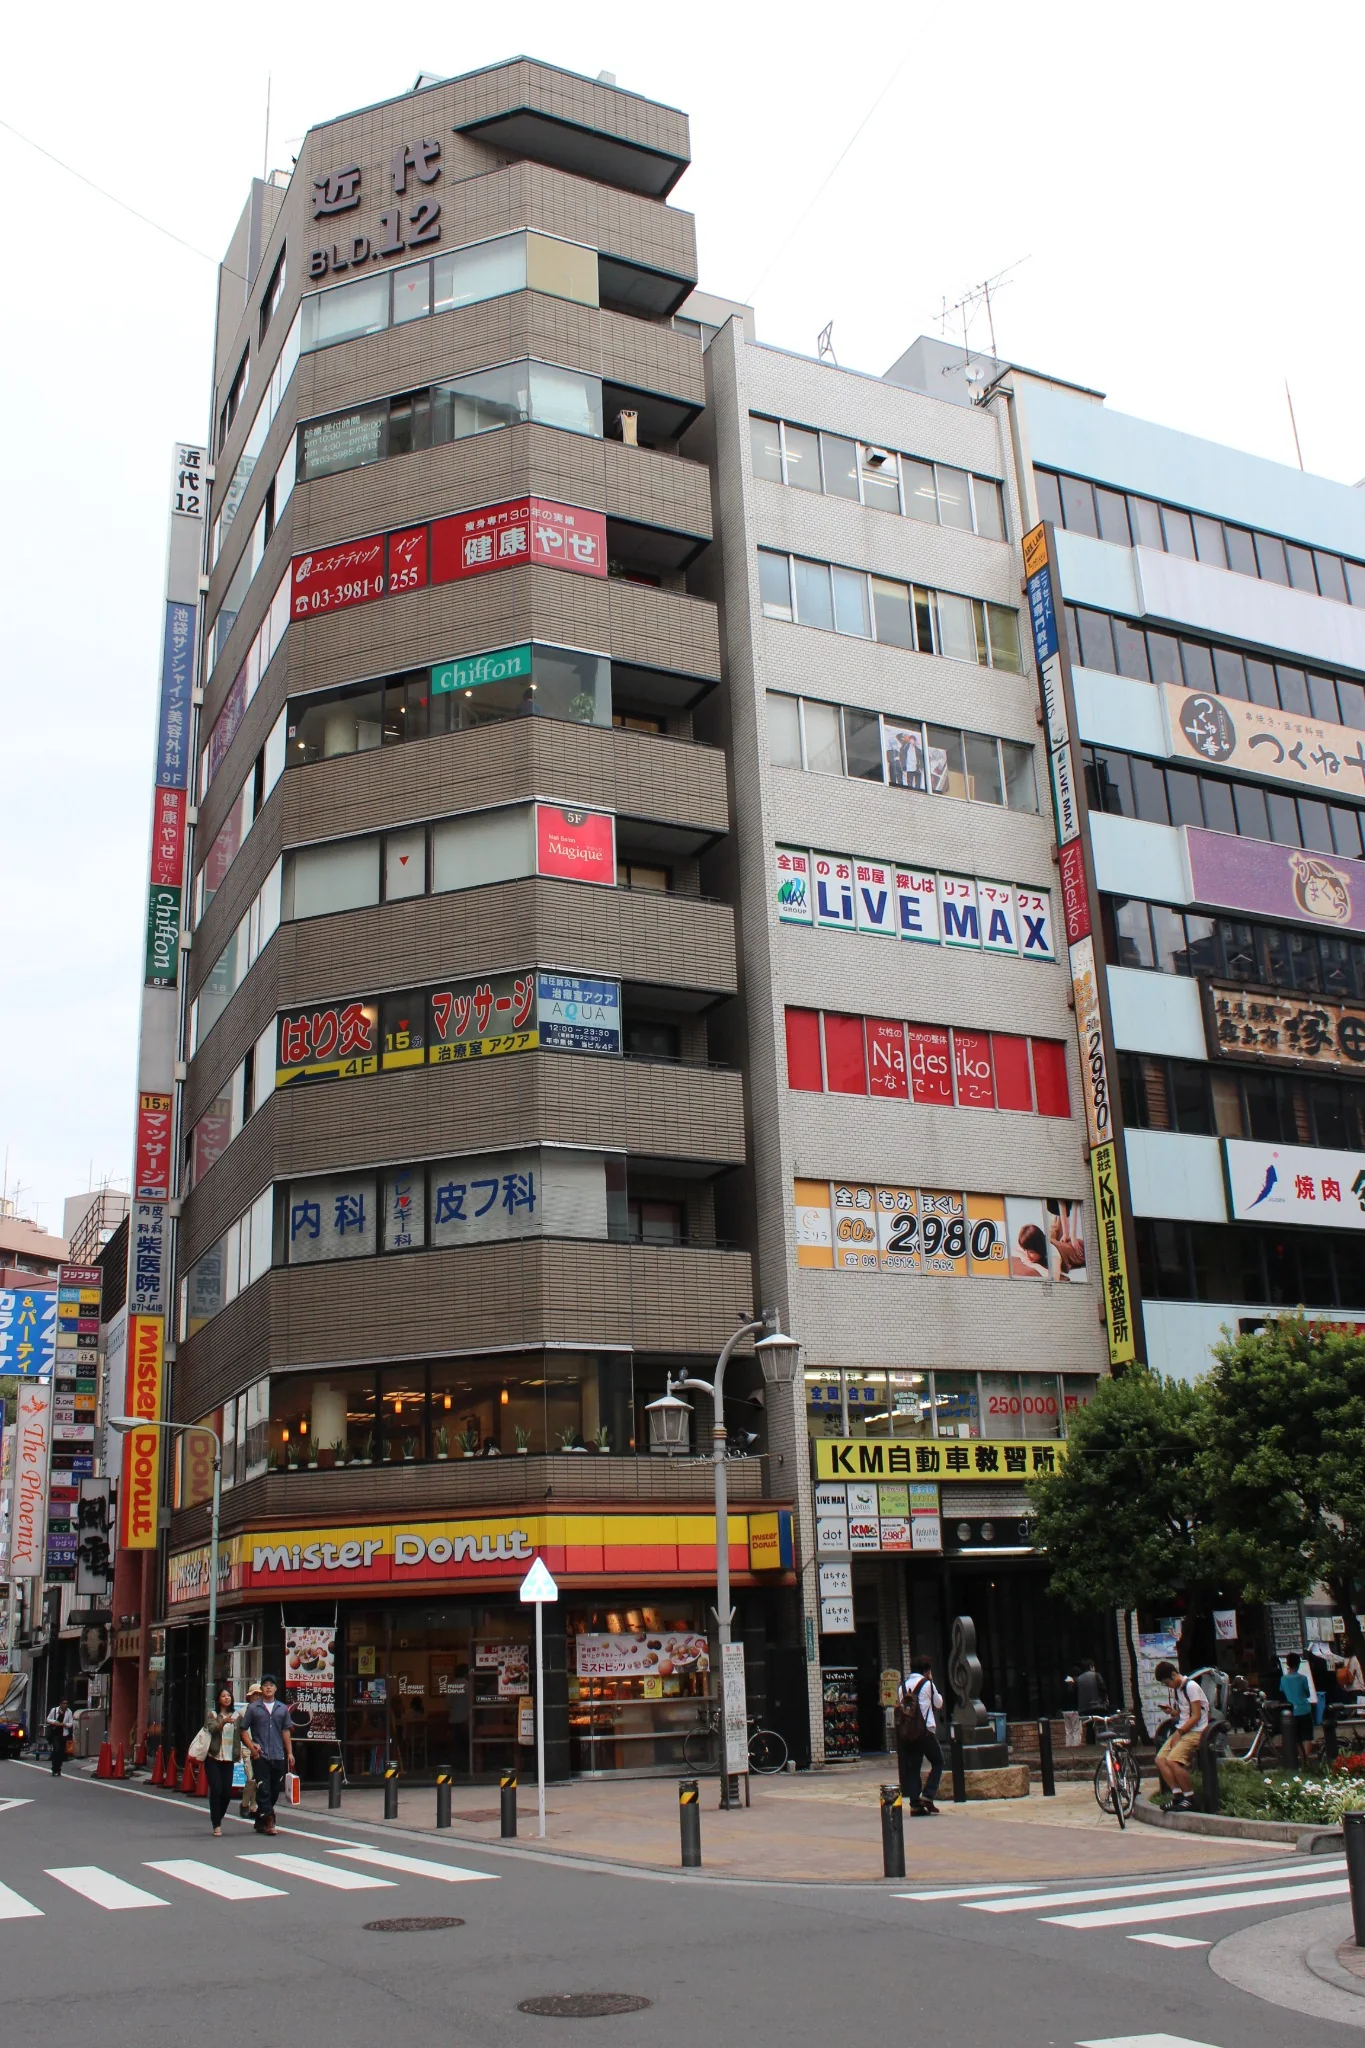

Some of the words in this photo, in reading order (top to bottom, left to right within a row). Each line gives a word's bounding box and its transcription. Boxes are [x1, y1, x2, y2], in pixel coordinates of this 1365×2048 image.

[313, 138, 441, 220] 近代
[308, 234, 378, 278] BLD.
[378, 200, 442, 257] 12
[178, 448, 201, 491] 近代
[175, 493, 200, 514] 12
[464, 526, 597, 566] 健康やせ
[439, 654, 522, 690] chiffon
[159, 791, 180, 860] 健康やせ
[567, 812, 583, 824] 5F
[783, 907, 807, 915] GROUP
[1062, 848, 1079, 937] Nadesiko
[154, 892, 180, 970] chiffon
[943, 901, 1049, 951] MAX
[153, 976, 169, 986] 6F
[431, 974, 535, 1040] マッサージ
[551, 1002, 606, 1021] AQUA
[281, 1002, 373, 1065] はり灸
[385, 1030, 424, 1052] 15分
[344, 1056, 373, 1077] 4F
[141, 1112, 168, 1185] マッサージ
[138, 1186, 165, 1198] 4F
[435, 1171, 537, 1225] 皮フ科
[1294, 1174, 1342, 1203] 焼肉
[290, 1193, 367, 1242] 内科
[135, 1236, 162, 1294] 柴医院
[136, 1294, 158, 1303] 3F
[22, 1423, 46, 1464] The
[831, 1445, 1056, 1474] KM自動車教習所
[132, 1434, 157, 1537] Donut
[11, 1469, 43, 1564] Phoenix
[822, 1529, 843, 1540] dot
[394, 1530, 534, 1567] Donut
[823, 1571, 848, 1580] はちすか
[832, 1580, 847, 1588] 小六
[825, 1607, 851, 1616] はちすか
[834, 1615, 849, 1624] 小六
